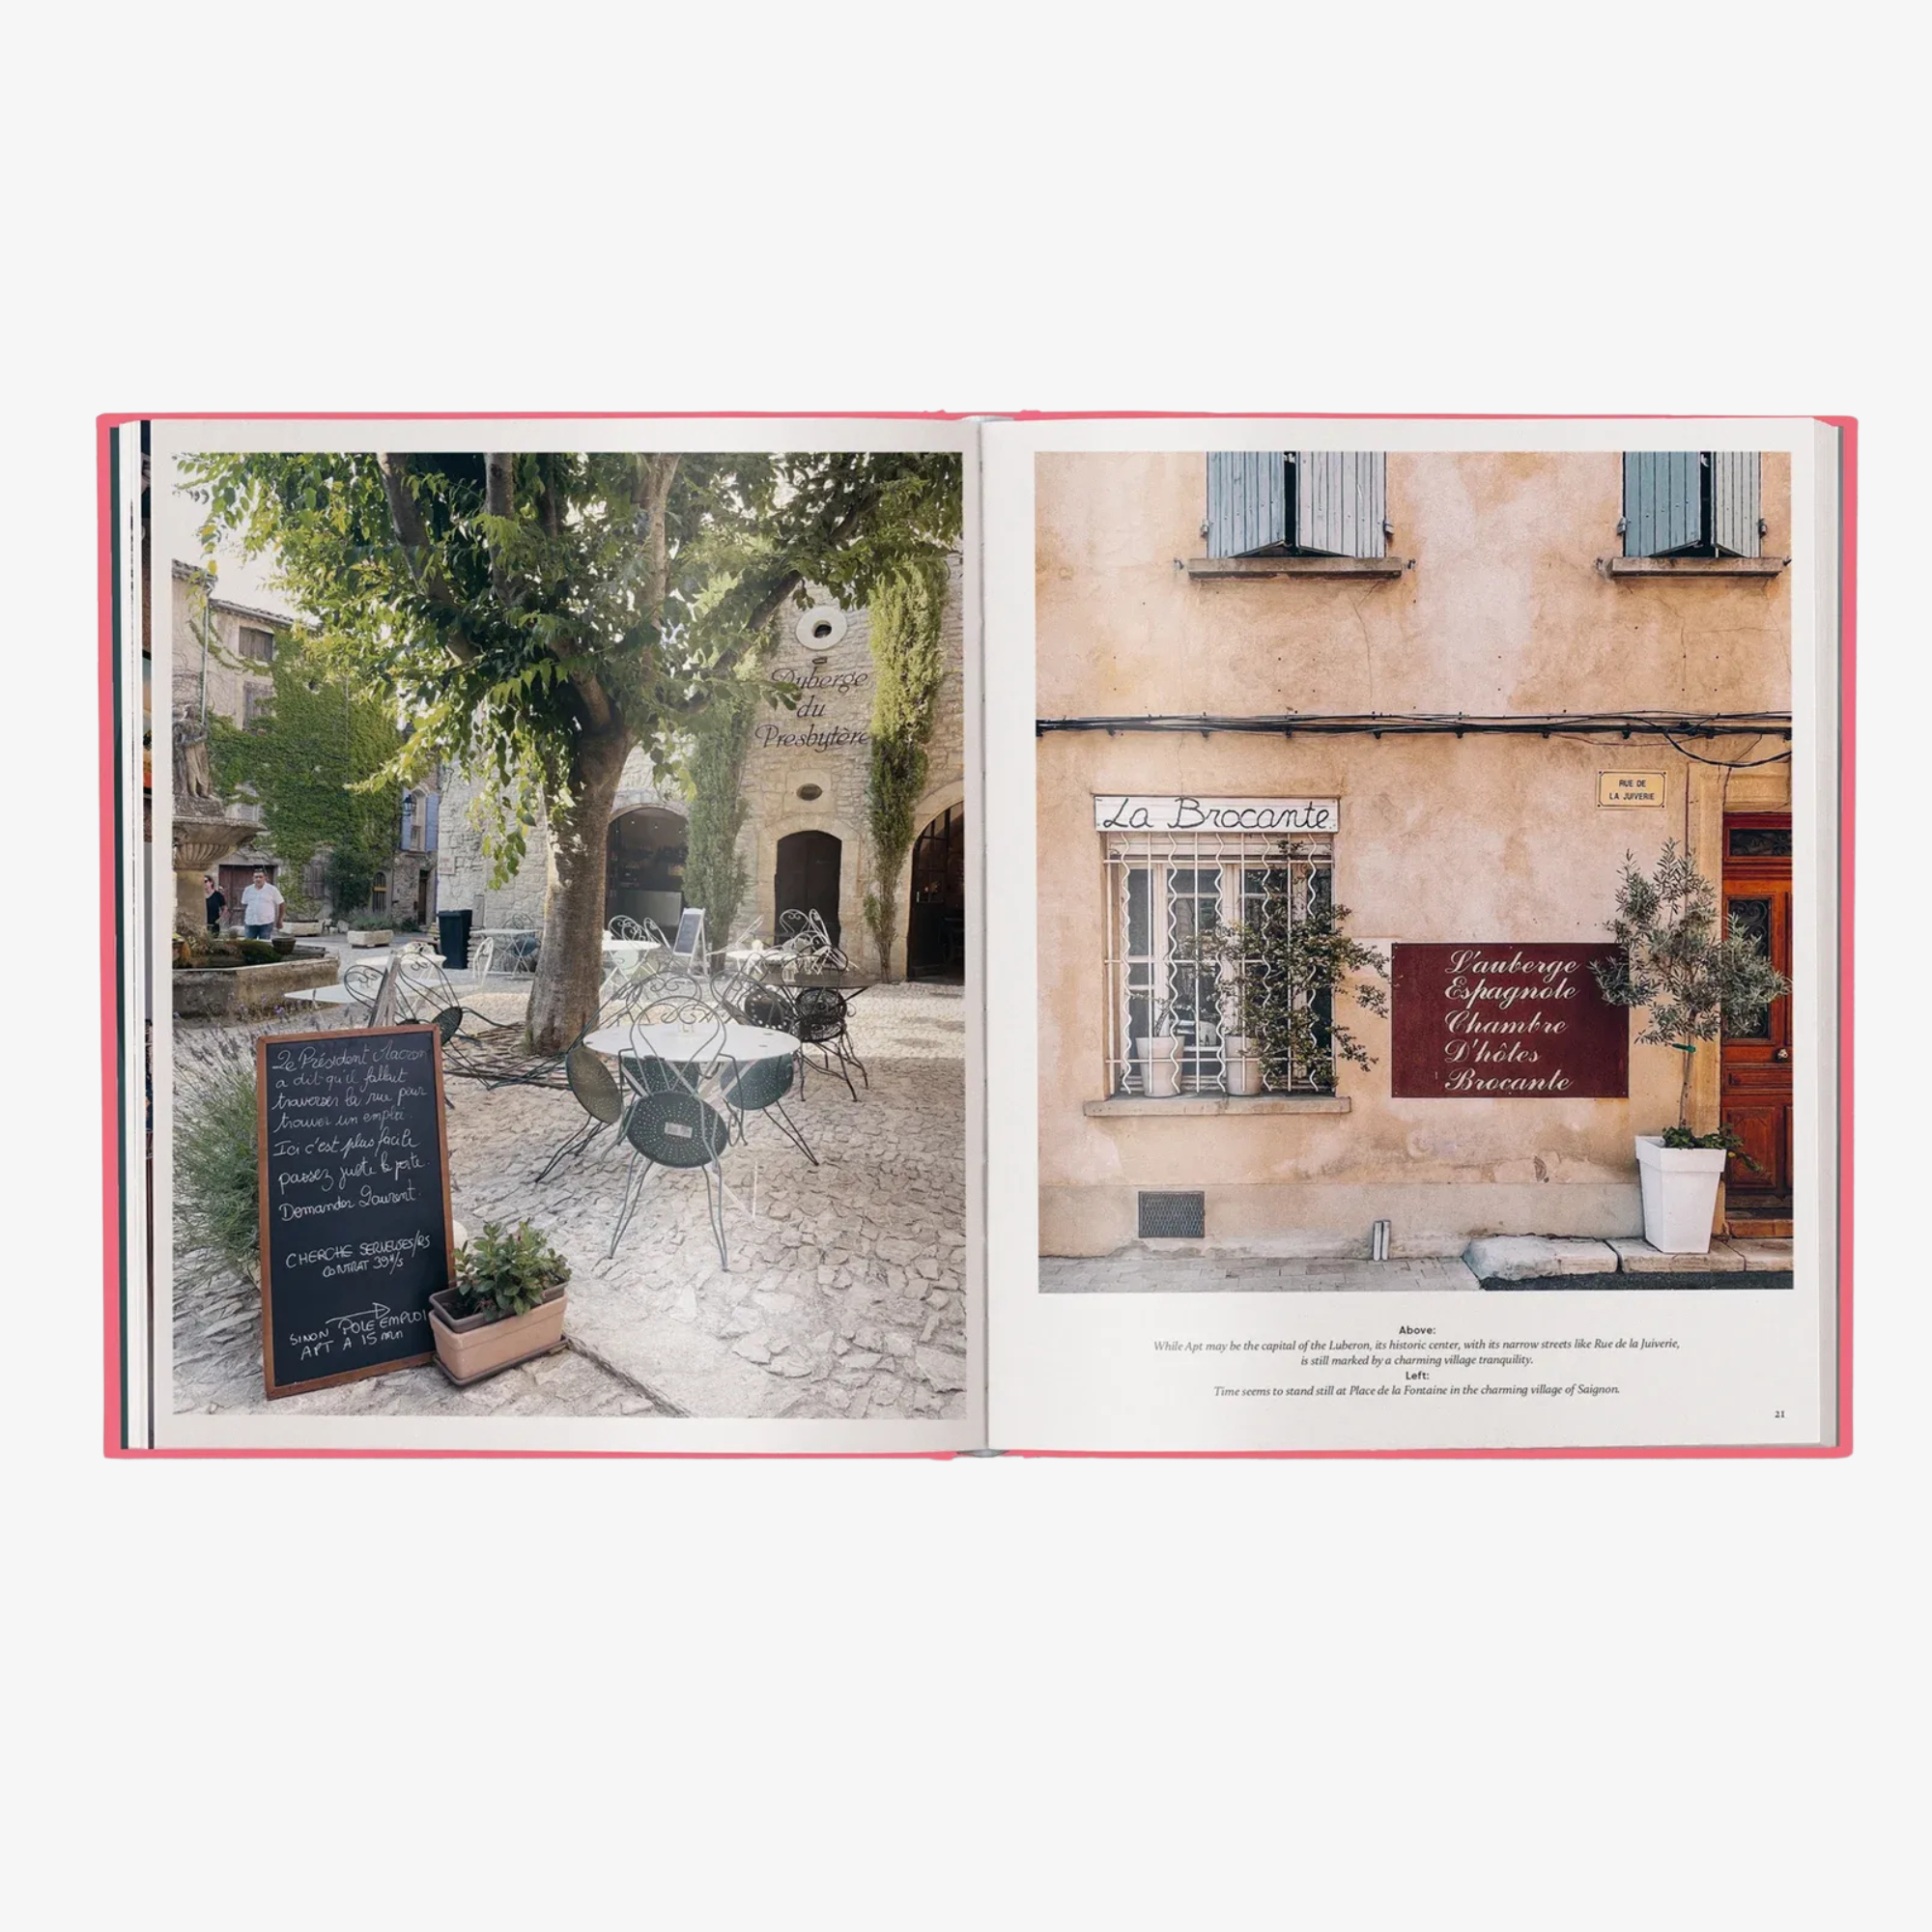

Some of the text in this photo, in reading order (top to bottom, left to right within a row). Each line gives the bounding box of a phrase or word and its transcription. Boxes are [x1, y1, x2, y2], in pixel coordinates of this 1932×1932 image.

[797, 695, 825, 718] du
[755, 724, 869, 753] Presbytère
[1103, 797, 1330, 829] La Brocante
[1445, 950, 1580, 983] L'auberge
[1445, 975, 1579, 1009] Espagnole
[1445, 1009, 1568, 1034] Chambre
[1444, 1038, 1542, 1063] D'hôtes
[275, 1079, 288, 1089] a
[293, 1071, 323, 1086] dit
[359, 1065, 408, 1093] fallait
[1445, 1067, 1574, 1091] Brocante
[271, 1086, 427, 1110] traverser la rue pour
[272, 1113, 331, 1133] trouver
[335, 1114, 358, 1126] un
[272, 1125, 420, 1159] Ici c'est plus facile
[278, 1169, 334, 1195] passez
[340, 1156, 377, 1189] juste
[278, 1196, 355, 1221] Demander
[286, 1244, 353, 1268] CHERCHE
[290, 1328, 329, 1346] SINON
[338, 1318, 375, 1335] POLE
[1398, 1325, 1435, 1334] Above:
[300, 1341, 334, 1360] APT
[342, 1338, 353, 1350] A
[362, 1332, 378, 1346] 15
[1153, 1340, 1184, 1350] While
[1184, 1341, 1203, 1352] Apt
[1206, 1344, 1228, 1352] may
[1229, 1340, 1241, 1350] be
[1243, 1341, 1260, 1350] the
[1262, 1340, 1296, 1352] capital
[1298, 1340, 1310, 1352] of
[1311, 1341, 1326, 1350] the
[1329, 1340, 1372, 1351] Luberon,
[1375, 1340, 1387, 1350] its
[1389, 1340, 1427, 1350] historic
[1429, 1341, 1461, 1350] center,
[1463, 1339, 1486, 1350] with
[1489, 1340, 1500, 1350] its
[1541, 1340, 1572, 1349] streets
[1575, 1339, 1592, 1349] like
[1594, 1339, 1613, 1349] Rue
[1615, 1338, 1628, 1349] de
[1630, 1338, 1639, 1349] la
[1640, 1338, 1680, 1350] Juiverie,
[1301, 1356, 1308, 1365] is
[1310, 1355, 1329, 1365] still
[1333, 1355, 1369, 1365] marked
[1372, 1355, 1384, 1368] by
[1394, 1355, 1442, 1367] charming
[1444, 1354, 1477, 1367] village
[1479, 1354, 1533, 1367] tranquility.
[1406, 1371, 1430, 1380] Left:
[1214, 1386, 1239, 1396] Time
[1273, 1387, 1284, 1396] to
[1286, 1385, 1314, 1396] stand
[1316, 1385, 1334, 1396] still
[1336, 1386, 1347, 1395] at
[1350, 1385, 1376, 1395] Place
[1378, 1385, 1389, 1395] de
[1392, 1385, 1402, 1395] la
[1404, 1384, 1448, 1395] Fontaine
[1450, 1385, 1461, 1395] in
[1463, 1384, 1479, 1394] the
[1481, 1384, 1528, 1397] charming
[1530, 1384, 1563, 1397] village
[1565, 1383, 1577, 1396] of
[1577, 1384, 1620, 1397] Saignon.
